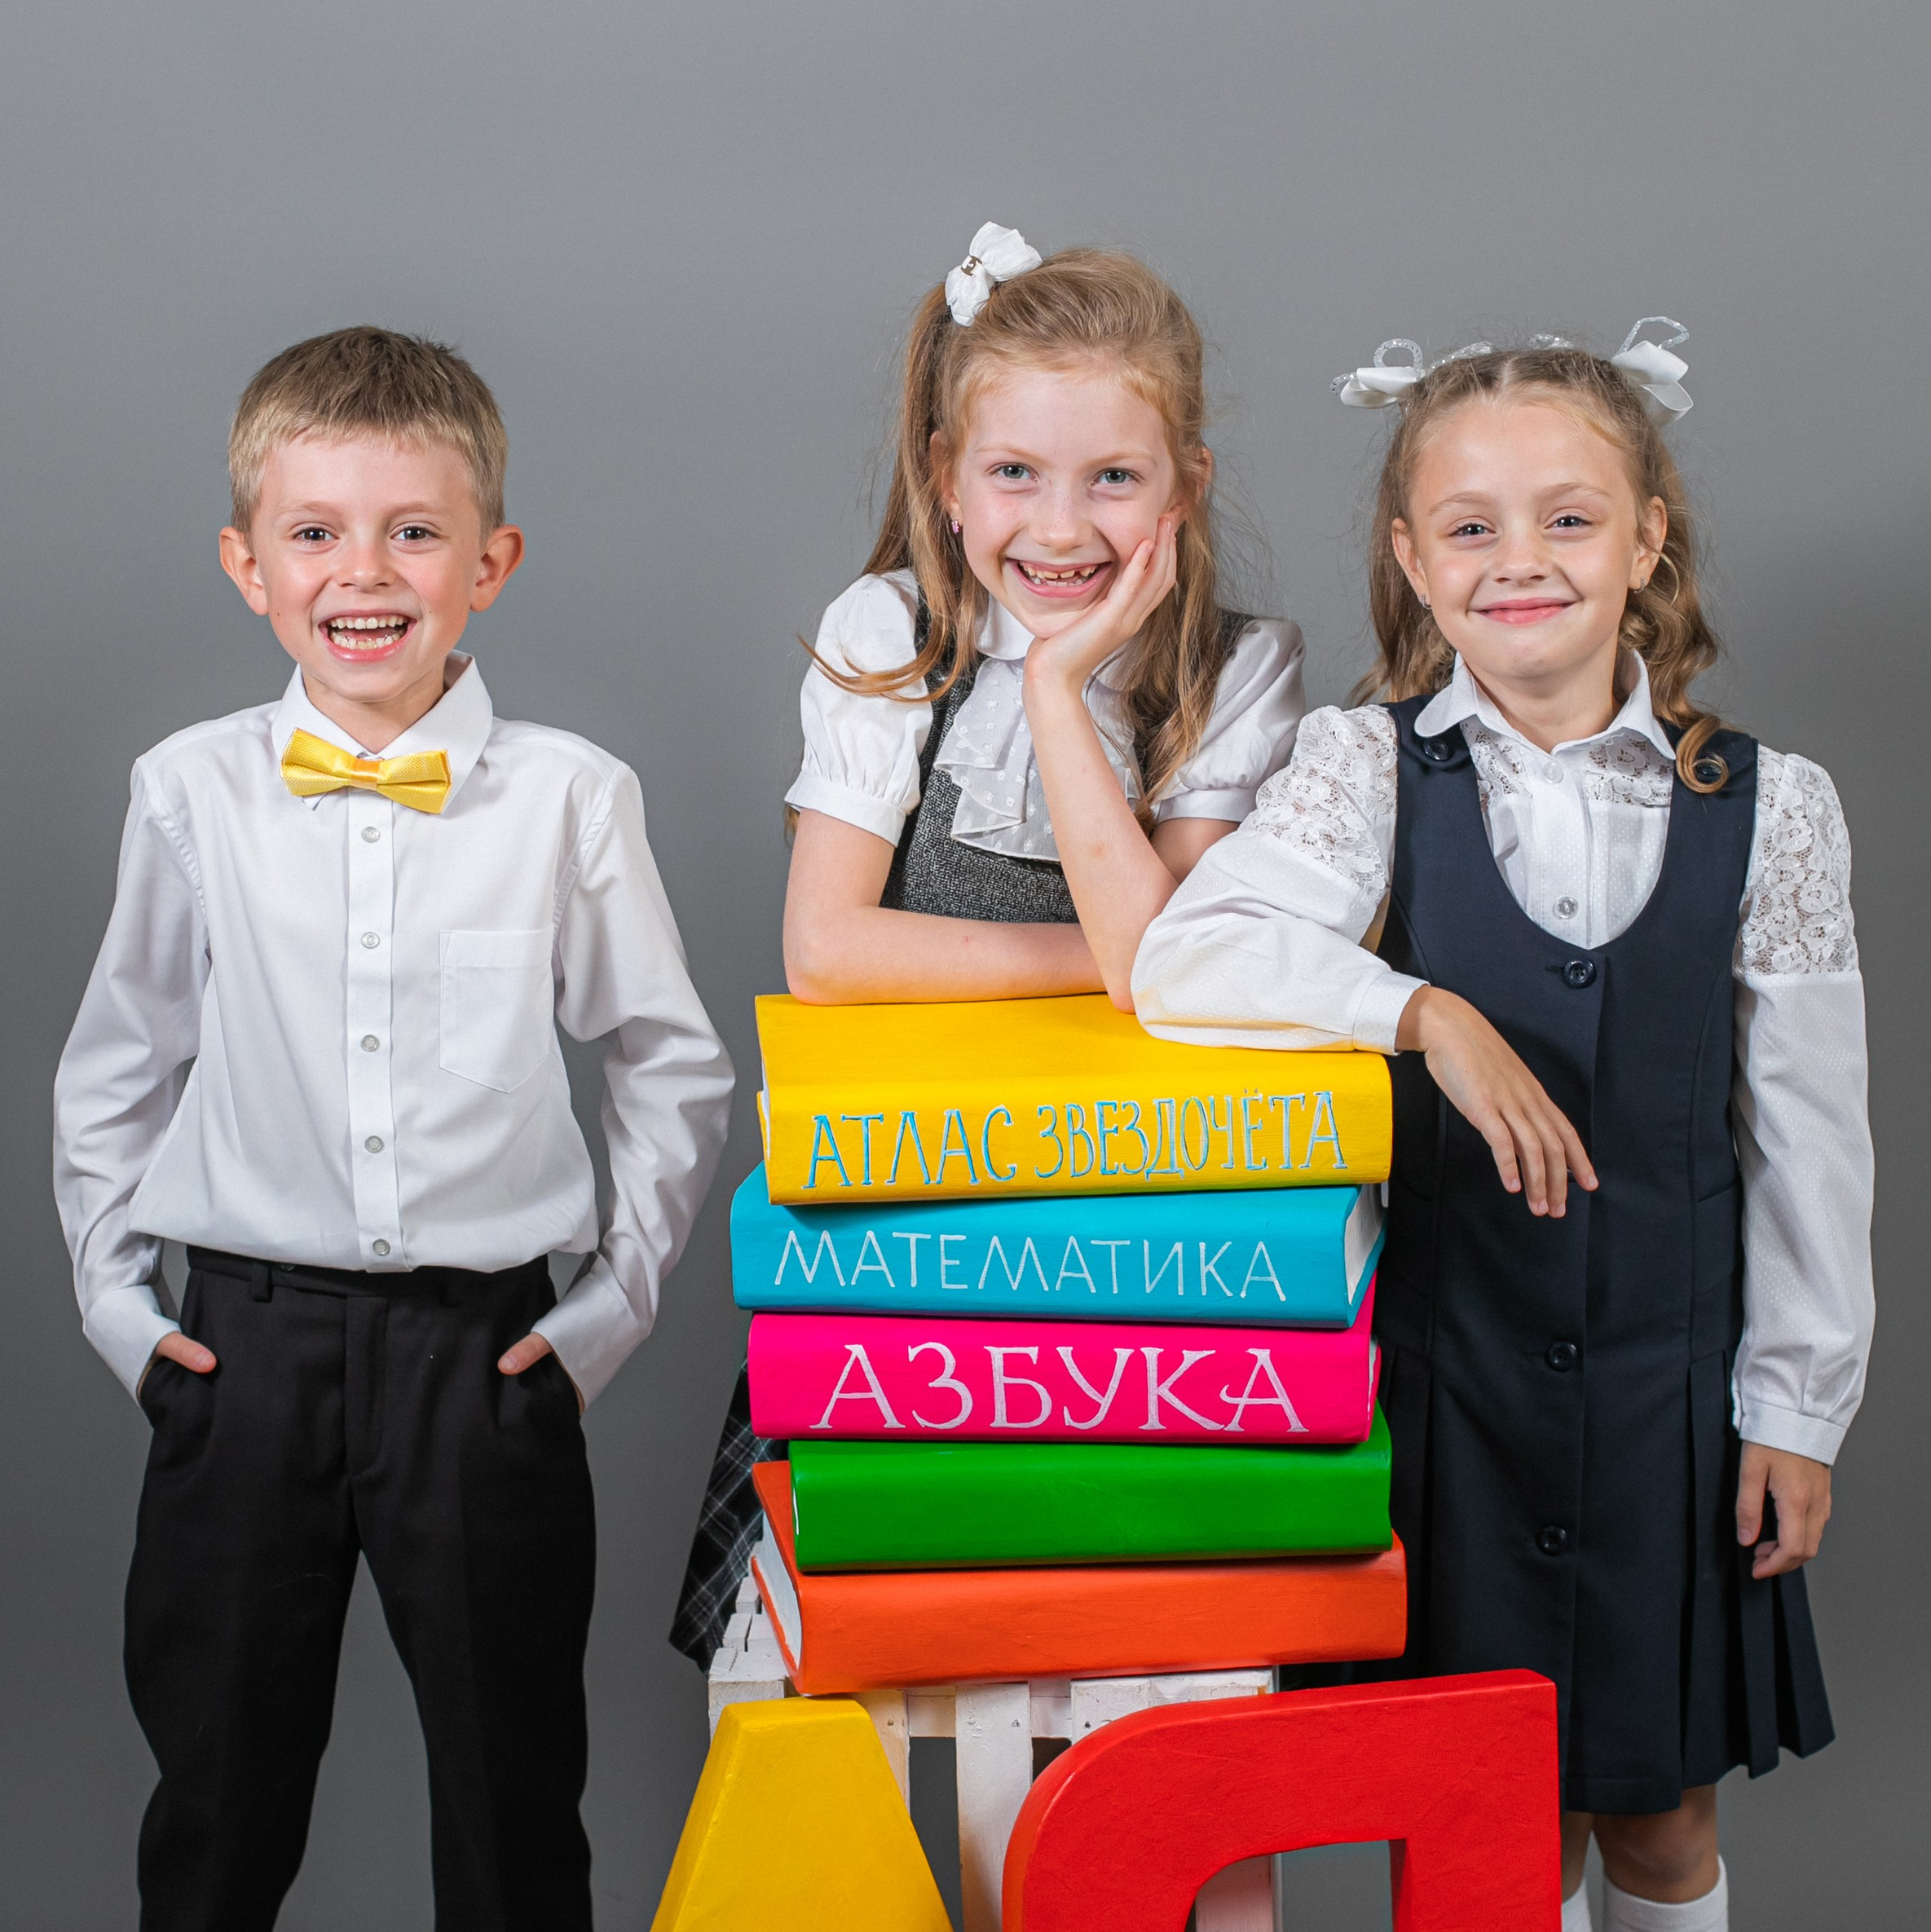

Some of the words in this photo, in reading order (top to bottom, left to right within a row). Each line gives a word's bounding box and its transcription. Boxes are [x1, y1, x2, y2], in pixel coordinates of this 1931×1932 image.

[801, 1105, 1016, 1189] АТЛАС
[1034, 1087, 1347, 1181] ЗВЕЗДОЧЁТА
[774, 1229, 1286, 1302] МАТЕМАТИКА
[809, 1341, 1309, 1433] АЗБУКА
